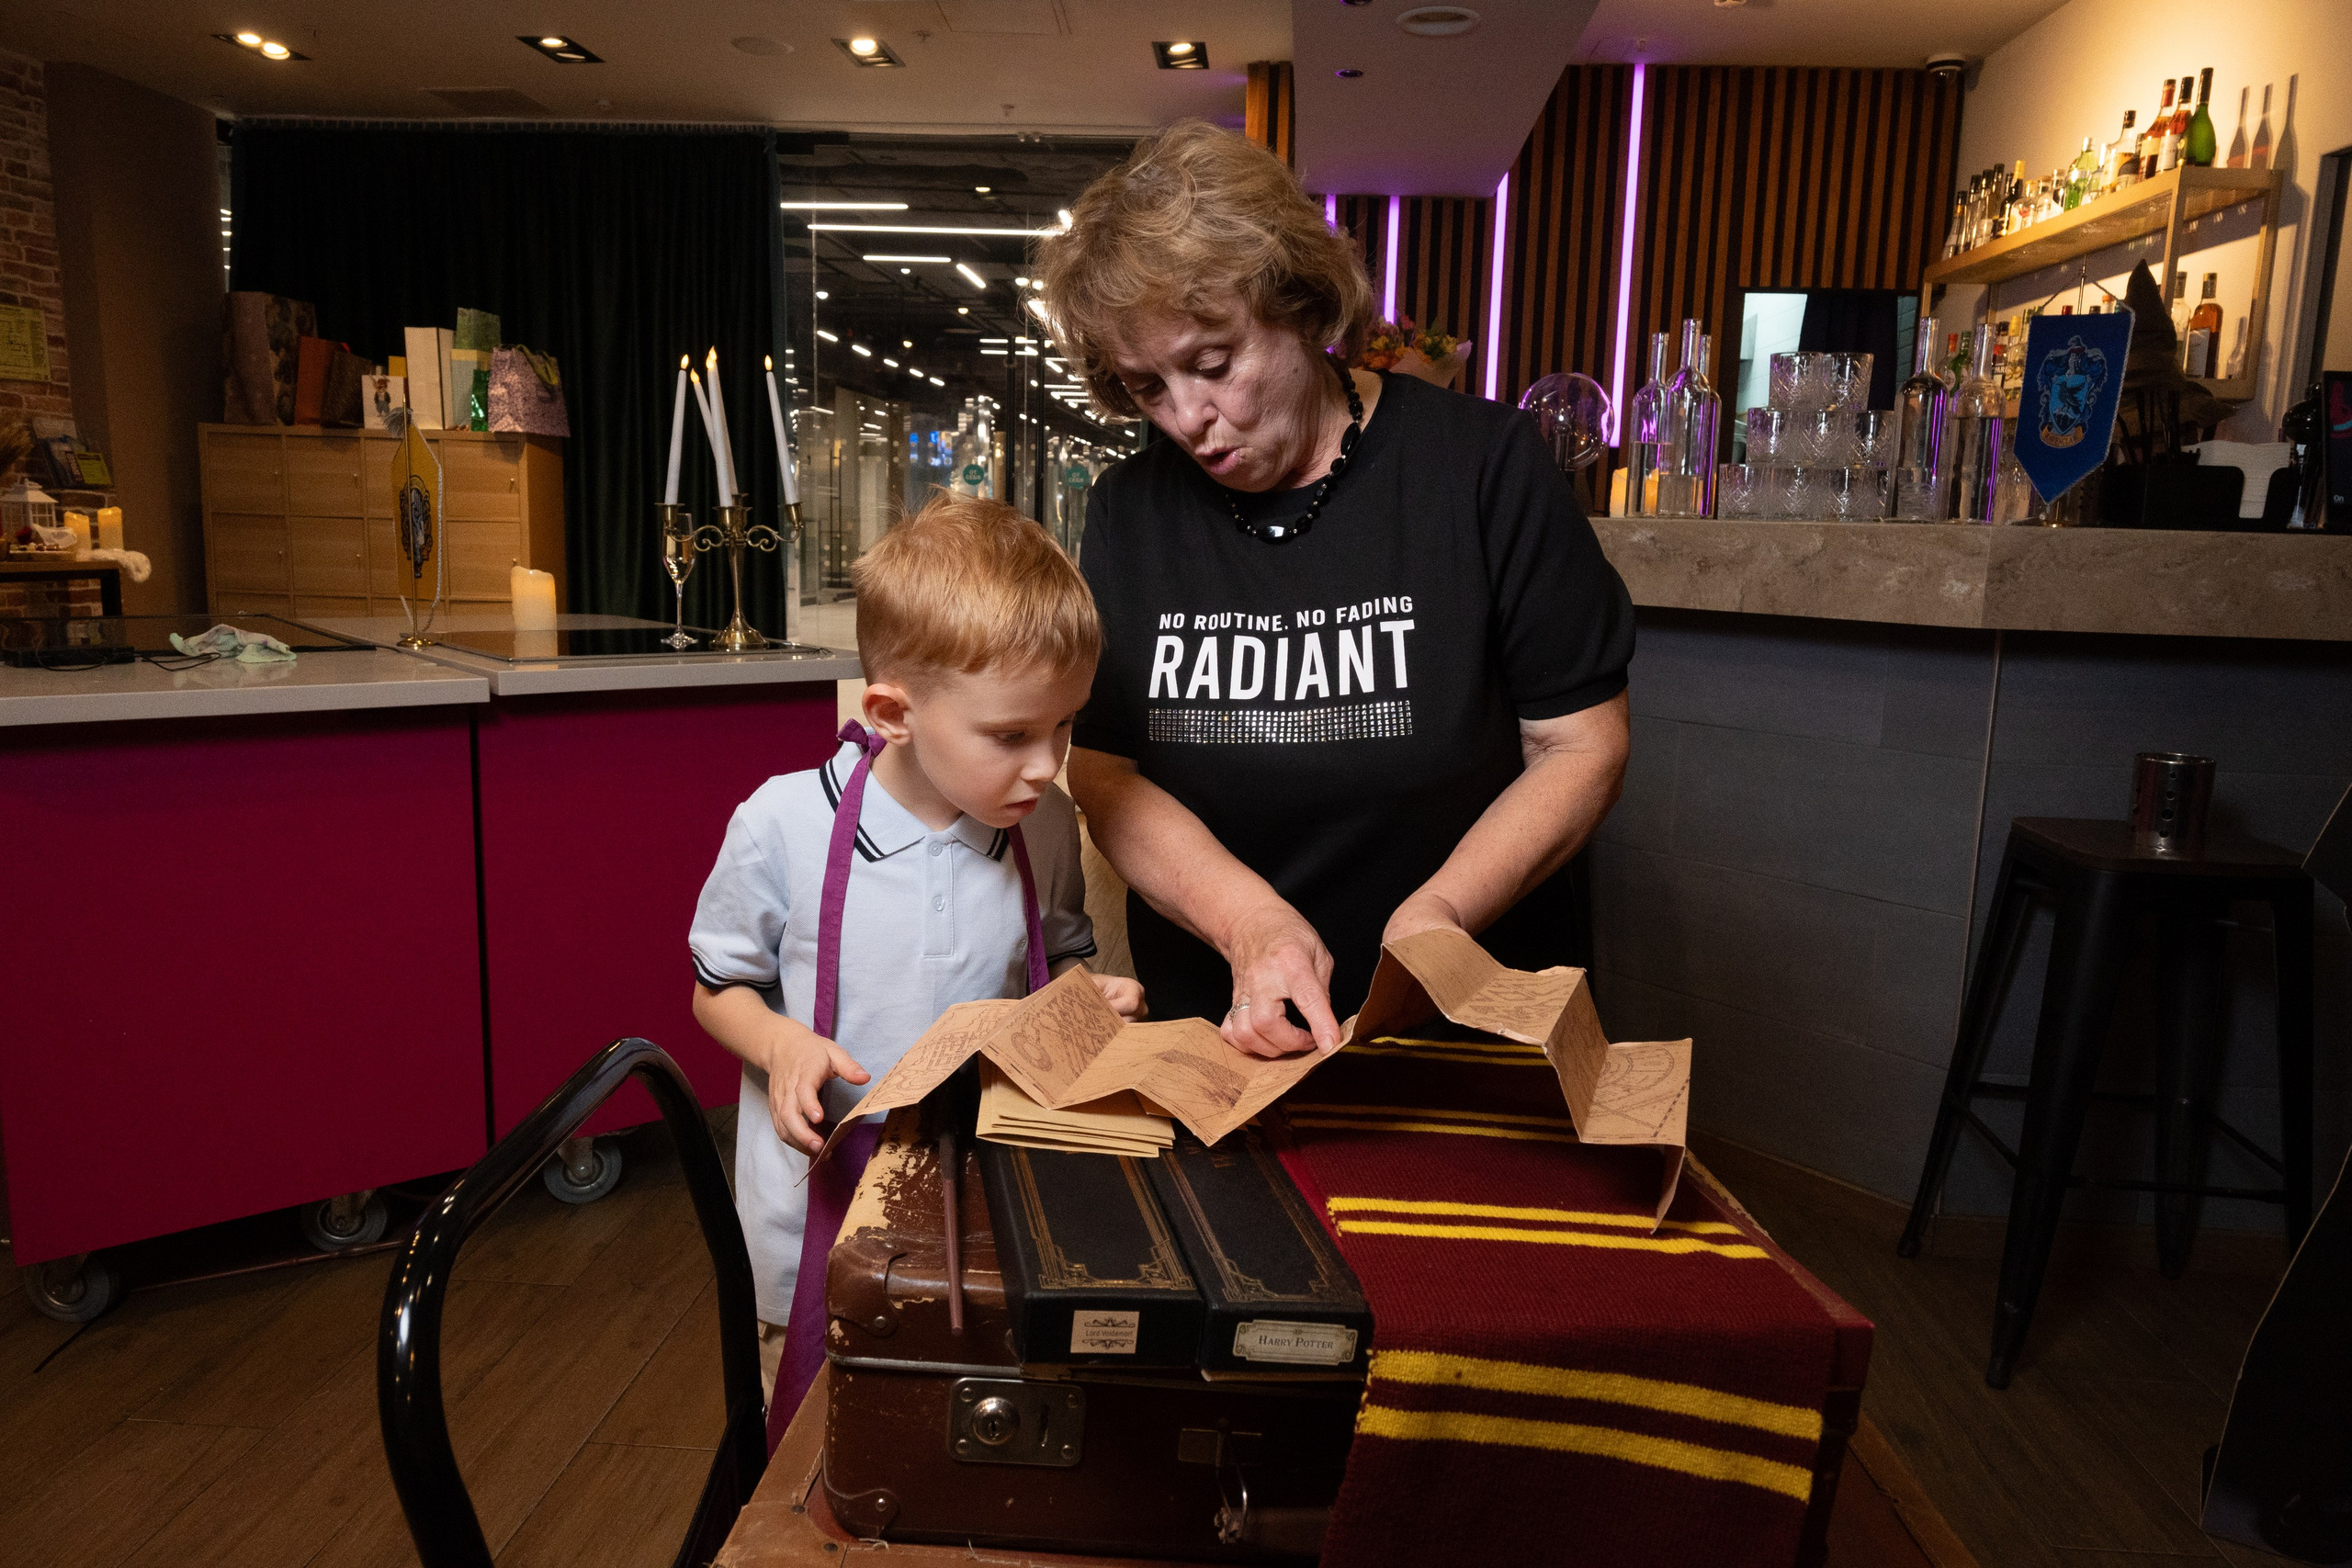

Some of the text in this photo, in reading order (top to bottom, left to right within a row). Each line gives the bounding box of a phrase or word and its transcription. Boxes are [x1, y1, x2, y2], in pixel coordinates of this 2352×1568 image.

[1159, 595, 1414, 632] NO ROUTINE. NO FADING
[1148, 619, 1415, 701] RADIANT
[1259, 1335, 1334, 1350] HARRY POTTER
